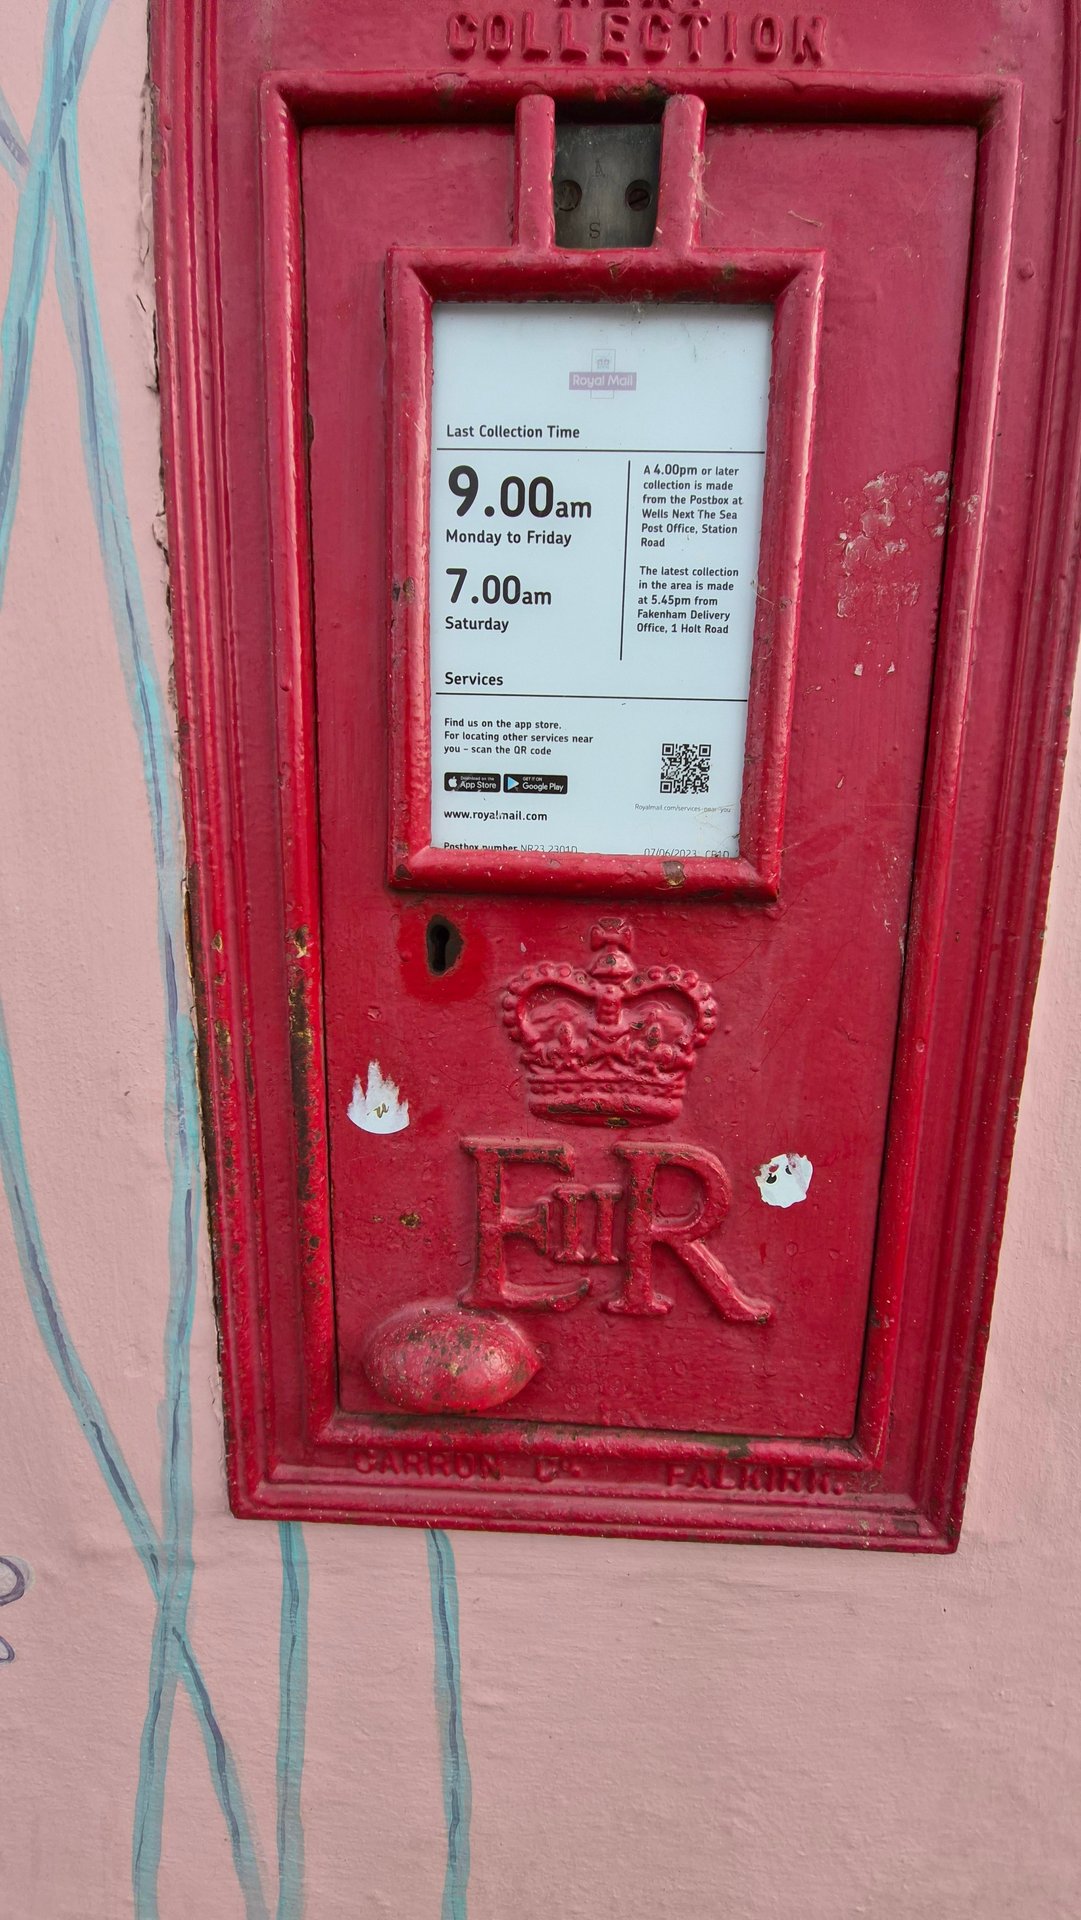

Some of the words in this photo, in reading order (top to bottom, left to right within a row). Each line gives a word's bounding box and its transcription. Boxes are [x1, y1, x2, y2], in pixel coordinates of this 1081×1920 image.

[447, 10, 828, 65] COLLECTION
[589, 222, 601, 239] S
[572, 374, 605, 388] Royal
[607, 374, 633, 386] Mail
[446, 425, 475, 437] Last
[479, 425, 543, 438] Collection
[547, 425, 580, 438] Time
[643, 465, 651, 475] A
[654, 464, 698, 477] 4.00pm
[701, 468, 713, 476] or
[715, 466, 740, 476] later
[448, 465, 592, 518] 9.00am
[643, 479, 691, 490] collection
[694, 480, 703, 490] is
[705, 480, 734, 491] made
[642, 494, 667, 504] from
[670, 495, 687, 505] the
[689, 495, 729, 505] Postbox
[732, 496, 743, 506] at
[642, 508, 670, 519] Wells
[672, 509, 695, 519] Next
[698, 509, 716, 520] The
[719, 510, 738, 520] Sea
[641, 523, 664, 533] Post
[666, 524, 698, 535] Office,
[701, 524, 738, 534] Station
[446, 529, 502, 546] Monday
[506, 531, 522, 544] to
[527, 530, 572, 547] Friday
[640, 537, 666, 547] Road
[639, 566, 658, 576] The
[661, 566, 689, 576] latest
[692, 567, 739, 577] collection
[445, 568, 552, 605] 7.00am
[638, 580, 648, 589] in
[651, 580, 668, 590] the
[671, 582, 692, 590] area
[695, 581, 704, 590] is
[707, 581, 735, 591] made
[638, 596, 648, 605] at
[651, 594, 691, 607] 5.45pm
[694, 596, 718, 606] from
[637, 609, 687, 619] Fakenham
[690, 610, 731, 622] Delivery
[445, 616, 510, 633] Saturday
[636, 622, 668, 634] Office,
[671, 624, 678, 633] 1
[681, 624, 702, 634] Holt
[704, 624, 729, 634] Road
[444, 672, 504, 686] Services
[444, 718, 465, 727] Find
[467, 720, 479, 728] us
[482, 720, 493, 728] on
[496, 719, 512, 728] the
[515, 721, 532, 731] app
[534, 720, 562, 730] store.
[444, 731, 460, 740] For
[462, 732, 500, 743] locating
[503, 733, 528, 742] other
[530, 733, 569, 743] services
[572, 735, 594, 743] near
[443, 747, 461, 755] you
[471, 747, 493, 755] scan
[496, 745, 511, 754] the
[513, 746, 527, 755] QR
[530, 746, 552, 755] code
[460, 780, 476, 789] App
[477, 781, 497, 789] Store
[522, 782, 548, 792] Google
[549, 783, 564, 792] Play
[443, 810, 548, 821] www.royalmail.com
[352, 1449, 504, 1481] CARRON
